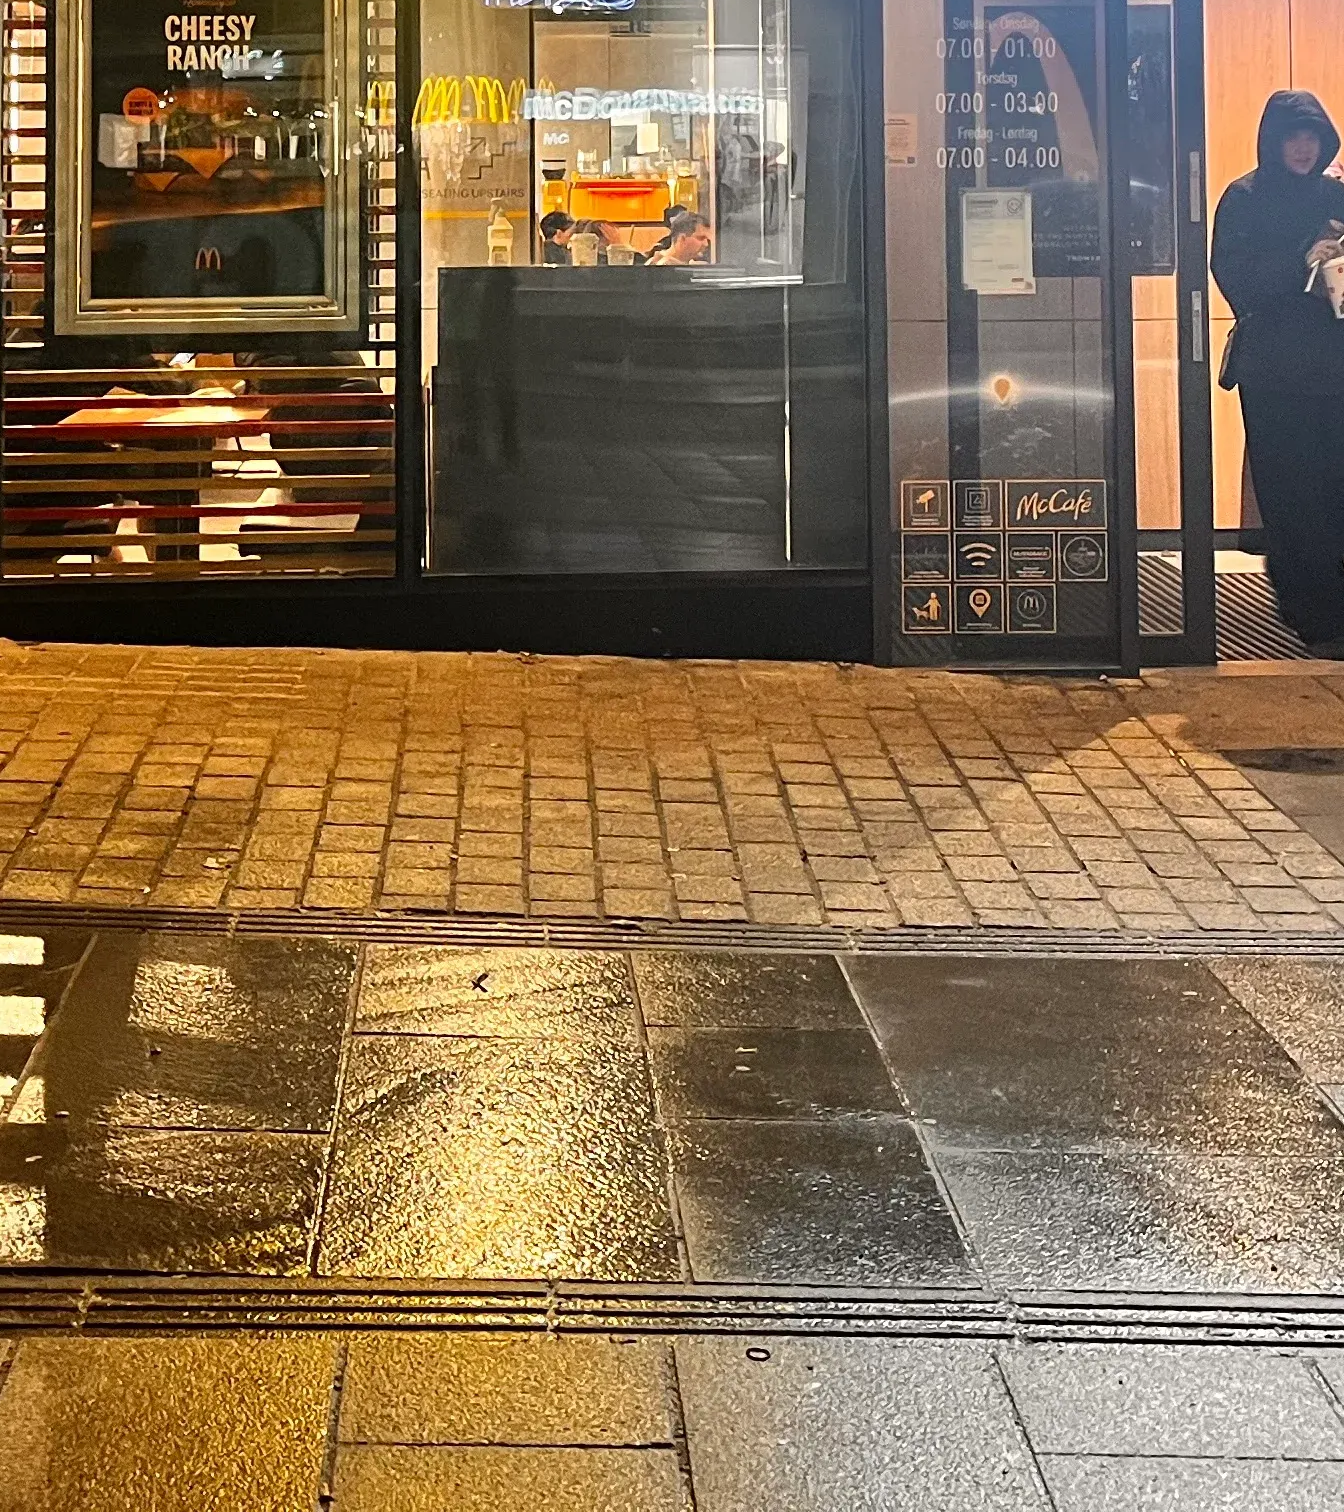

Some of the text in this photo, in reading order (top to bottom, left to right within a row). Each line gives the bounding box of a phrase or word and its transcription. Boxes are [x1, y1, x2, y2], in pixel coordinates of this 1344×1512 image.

[164, 14, 257, 42] CHEESY
[166, 44, 250, 71] RANCH
[935, 37, 985, 59] 07.00
[1004, 37, 1056, 59] 01.00
[975, 71, 1018, 88] Torsdag
[935, 91, 983, 114] 07.00
[1004, 91, 1058, 114] 03.00
[957, 126, 994, 143] Fredag
[1001, 126, 1038, 143] Lørdag
[936, 147, 985, 169] 07.00
[1004, 147, 1060, 169] 04.00
[421, 188, 525, 200] SEATING UPSTAIRS
